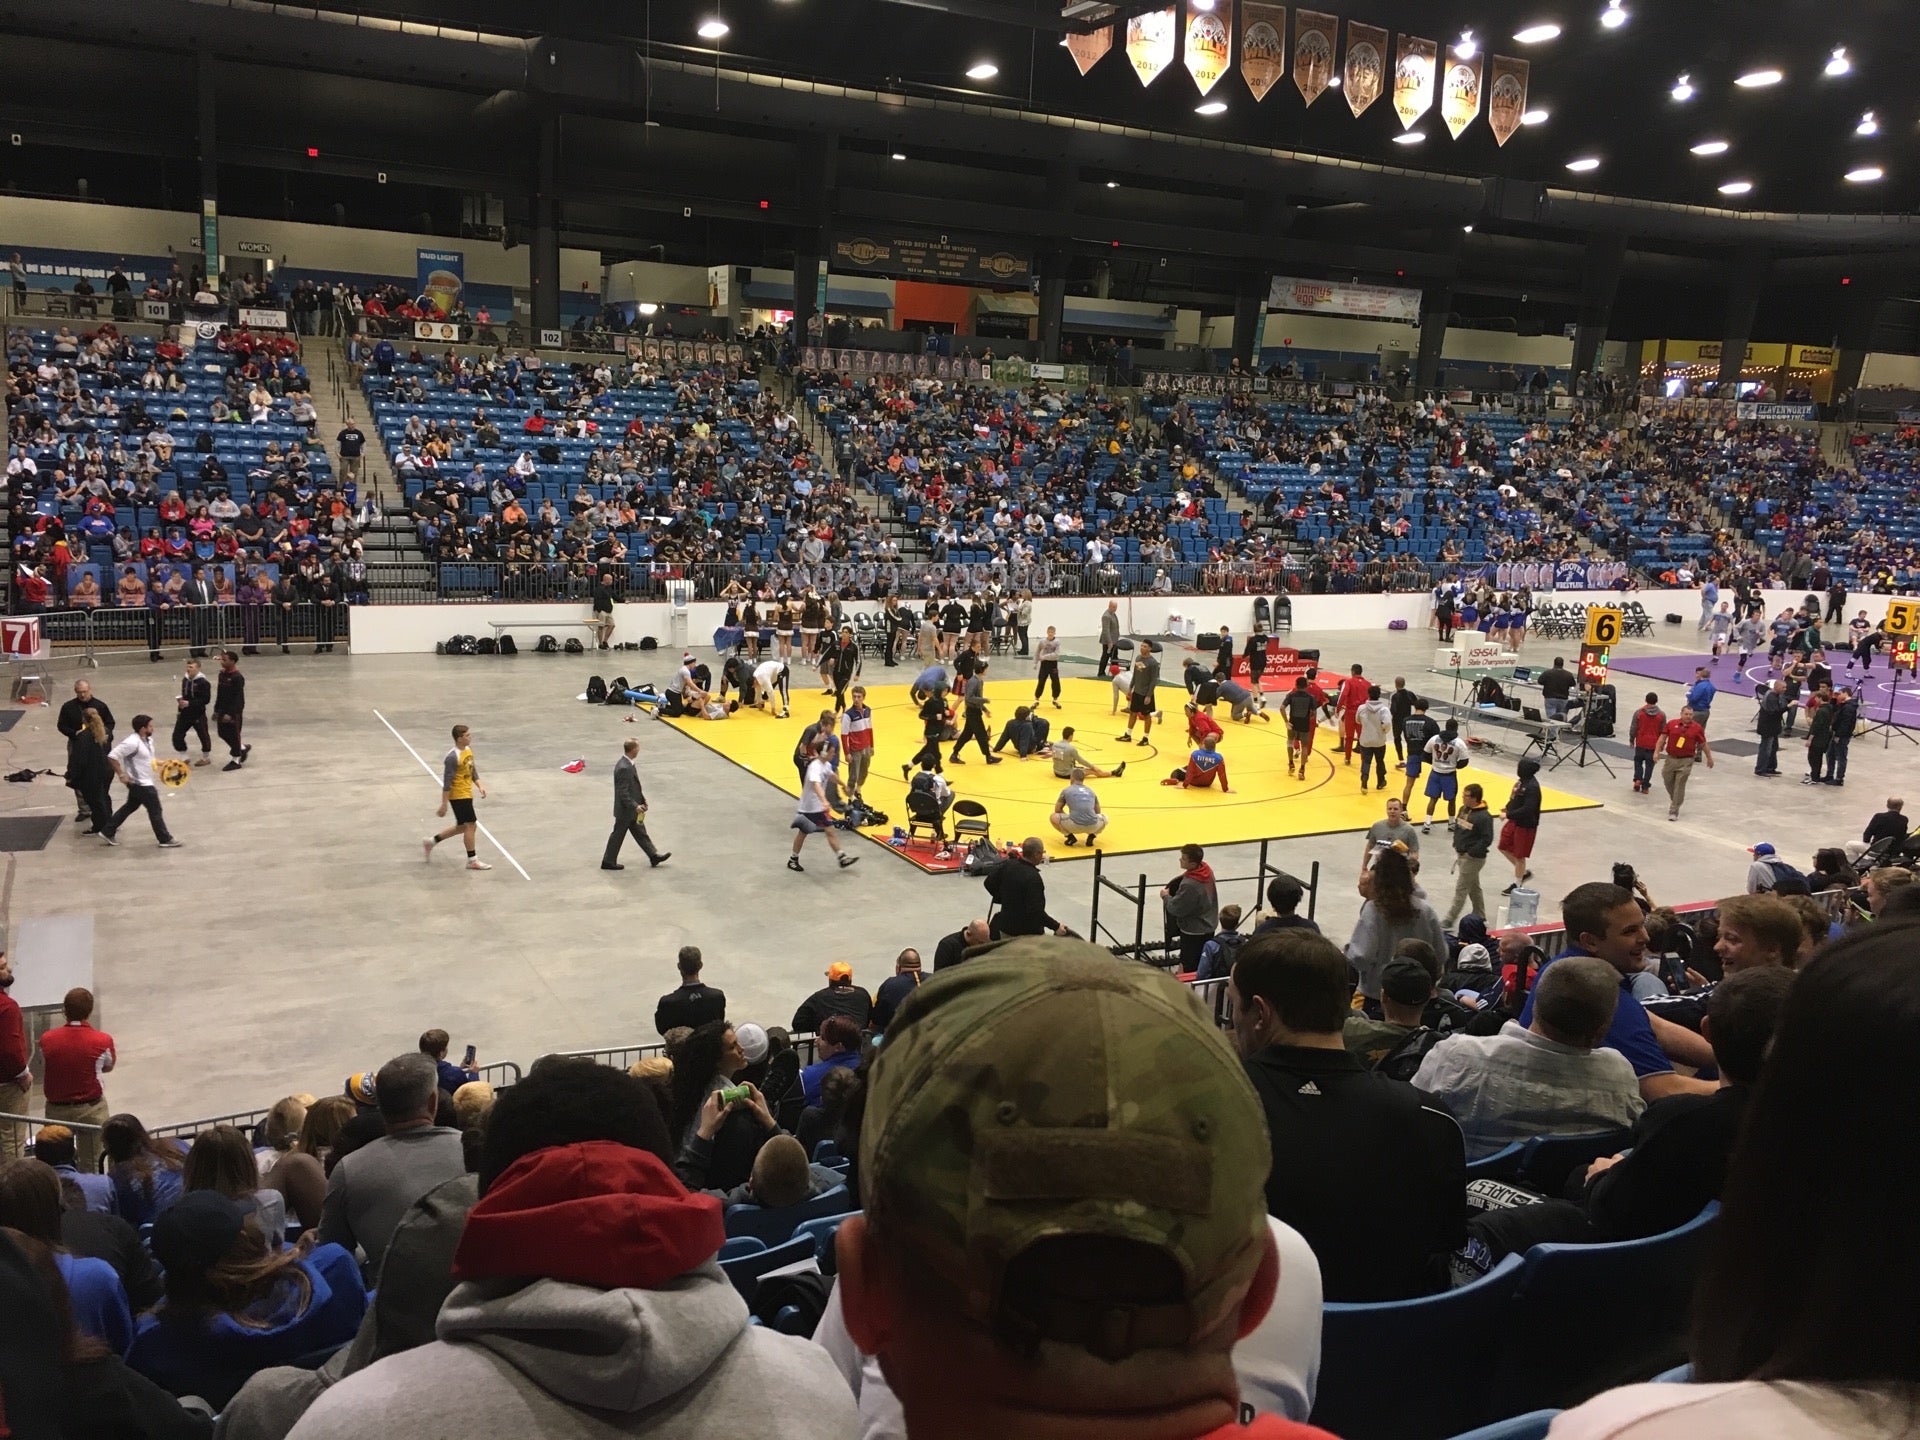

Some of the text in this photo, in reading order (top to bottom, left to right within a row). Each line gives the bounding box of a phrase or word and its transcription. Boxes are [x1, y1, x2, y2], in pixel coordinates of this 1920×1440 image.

[1075, 49, 1098, 60] 2012
[1137, 61, 1159, 71] 2012
[1195, 70, 1216, 80] 2012
[1449, 117, 1466, 126] 2009
[239, 243, 271, 252] WOMEN
[952, 245, 977, 253] WICHITA
[420, 252, 459, 262] BUD LIGHT
[1296, 295, 1314, 307] egg
[148, 305, 165, 316] 101
[543, 333, 560, 343] 102
[1758, 405, 1812, 414] LEAVENWORTH
[1556, 562, 1585, 578] ANDOVER
[1556, 581, 1584, 589] WRESTLING
[1891, 606, 1908, 630] 5
[1596, 614, 1615, 641] 6
[6, 624, 26, 651] 7
[1897, 642, 1916, 651] 0 0
[1469, 648, 1498, 657] KSHSAA
[1896, 652, 1915, 661] 2:00
[1266, 654, 1294, 664] SHSAA
[1586, 653, 1608, 665] 0 0
[1239, 661, 1251, 674] 6A
[1263, 665, 1275, 673] tate
[1585, 665, 1607, 676] 2:00
[1197, 755, 1216, 764] TITANS
